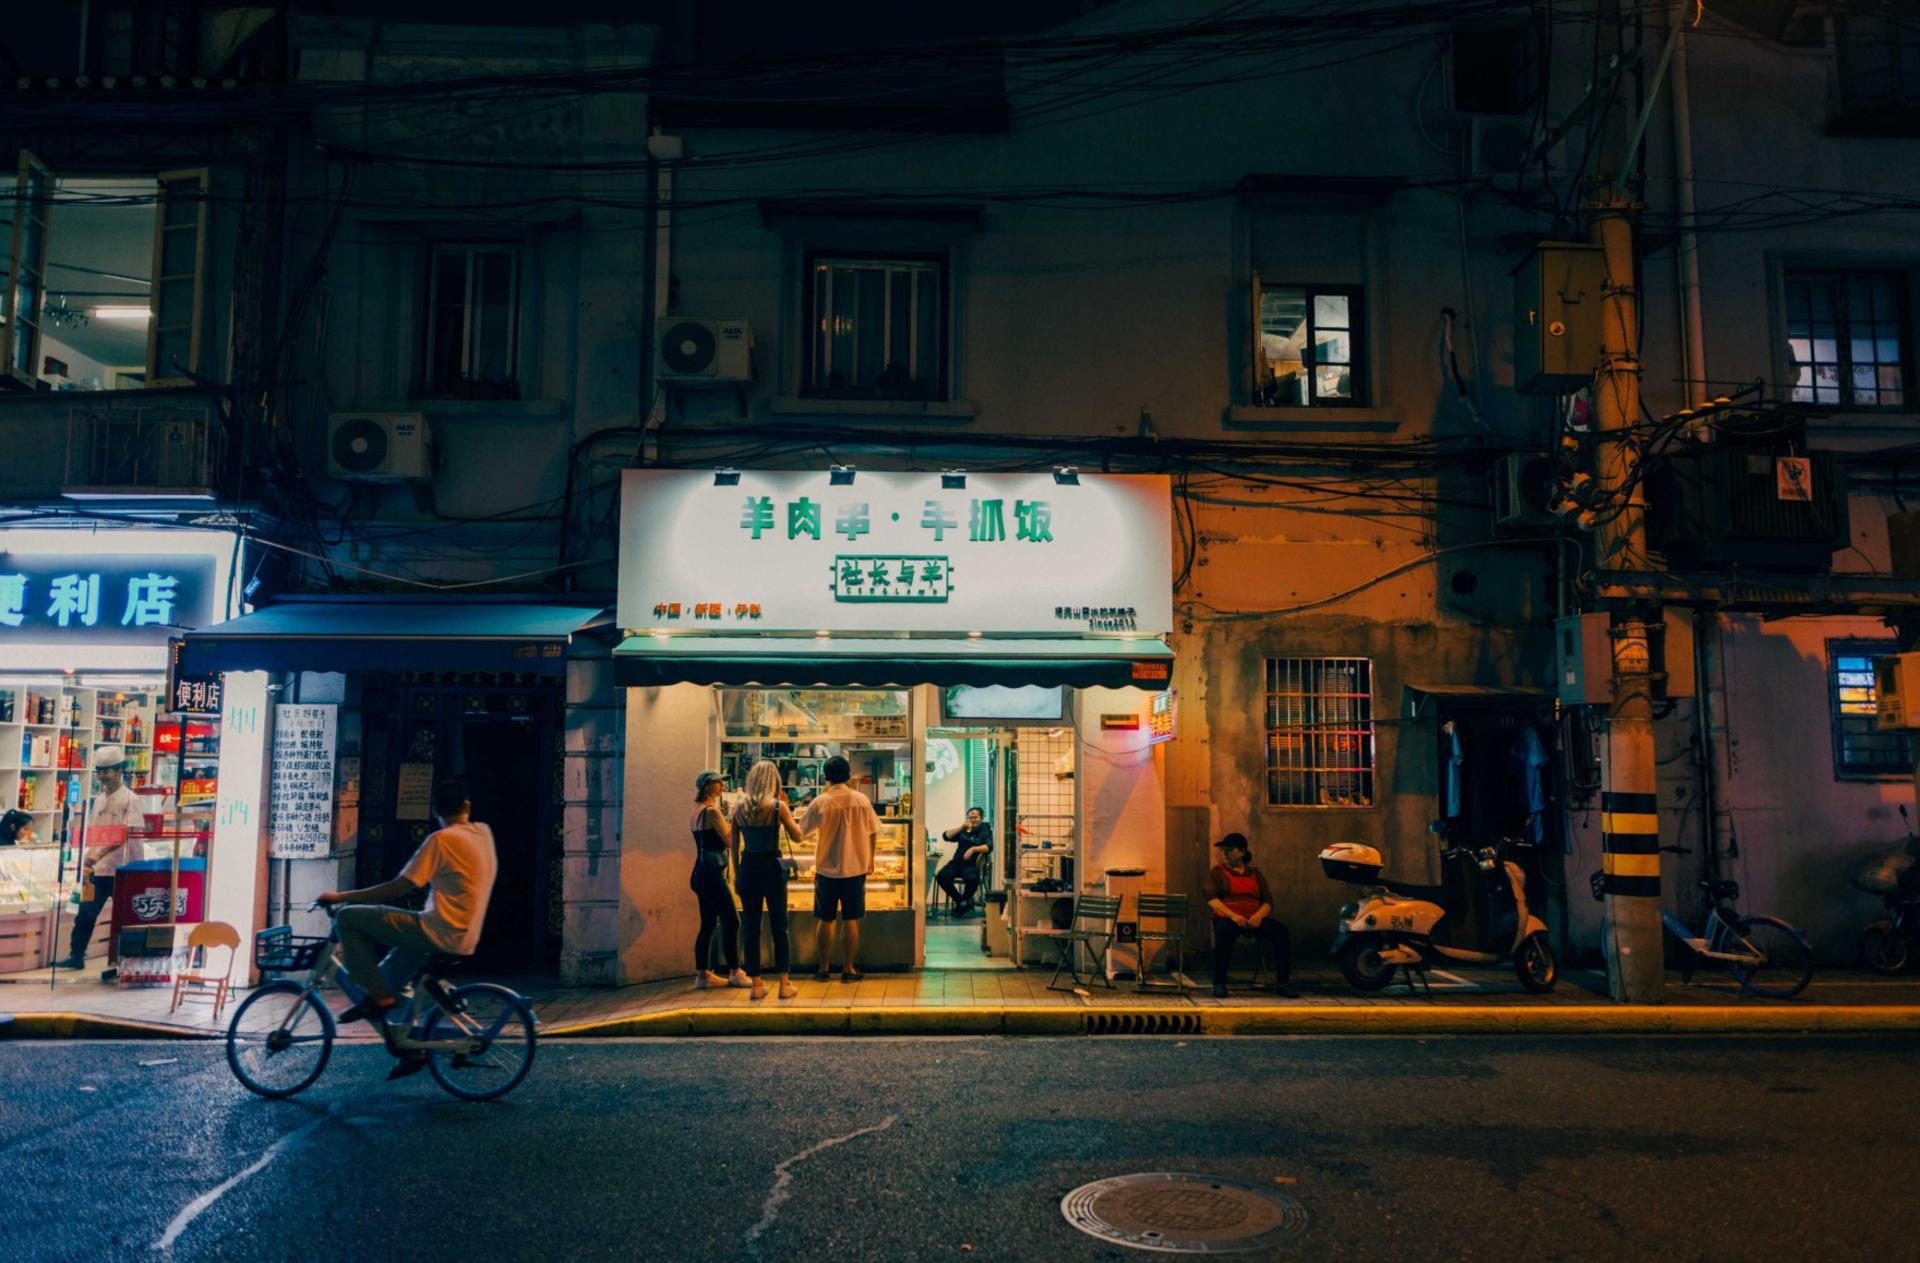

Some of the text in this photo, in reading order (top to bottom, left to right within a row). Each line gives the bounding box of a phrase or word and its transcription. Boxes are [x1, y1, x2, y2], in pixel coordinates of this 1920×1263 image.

[840, 559, 943, 589] 社长与羊
[176, 680, 220, 709] 便利店
